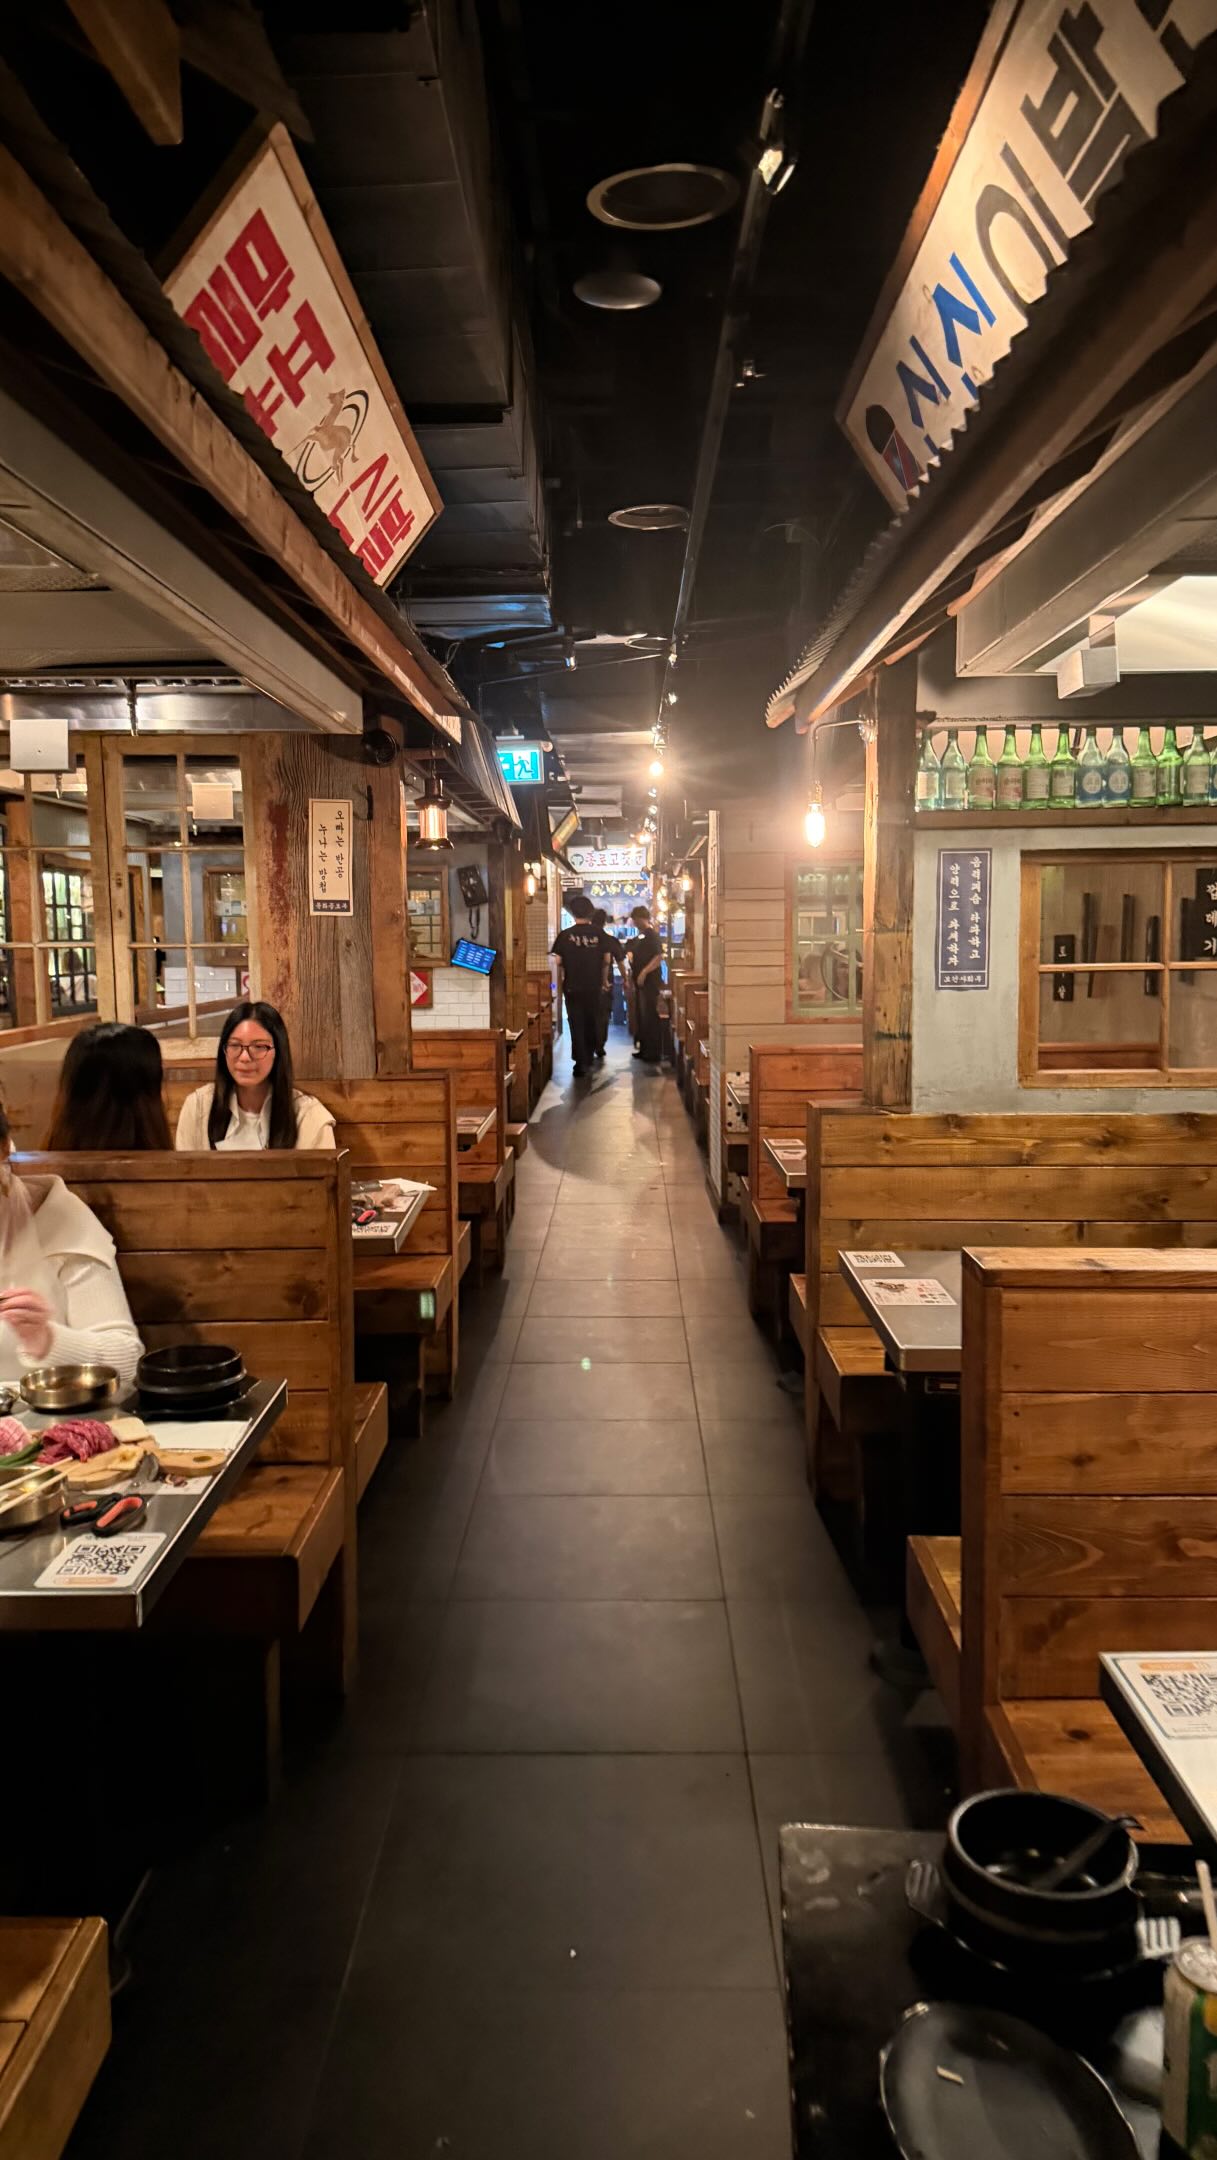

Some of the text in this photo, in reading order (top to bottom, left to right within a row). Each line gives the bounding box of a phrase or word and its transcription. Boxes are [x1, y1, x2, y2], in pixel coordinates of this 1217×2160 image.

[976, 0, 1200, 312] 이발
[318, 823, 328, 894] 누나는 방첩
[335, 810, 345, 879] 오빠는 반공
[947, 863, 961, 912] 양력으로
